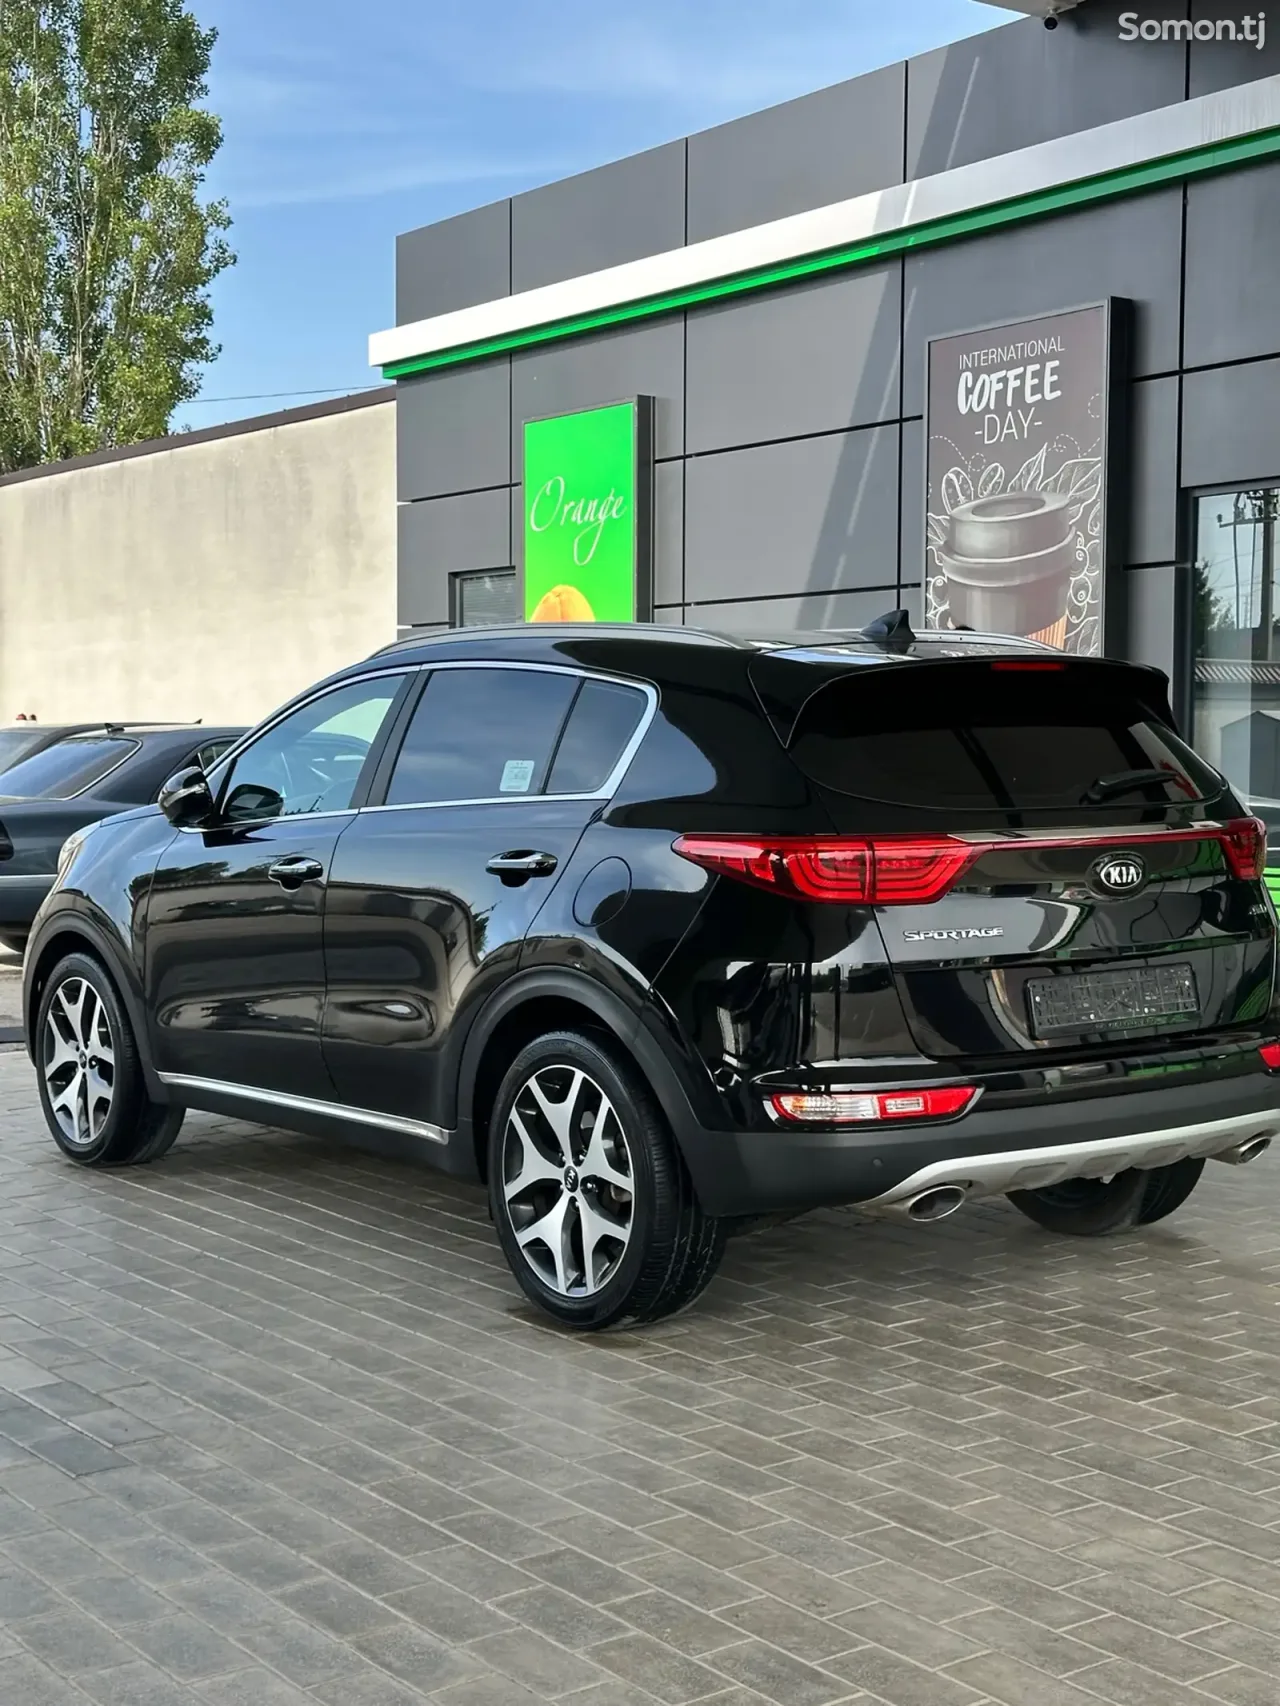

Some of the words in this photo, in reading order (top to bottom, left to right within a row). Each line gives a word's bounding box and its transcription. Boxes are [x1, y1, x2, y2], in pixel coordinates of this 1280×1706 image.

[959, 336, 1065, 370] INTERNATIONAL
[957, 360, 1062, 415] COFFEE
[530, 476, 627, 566] Orange
[1108, 866, 1138, 884] KIA
[903, 926, 1004, 942] SPORTAGE
